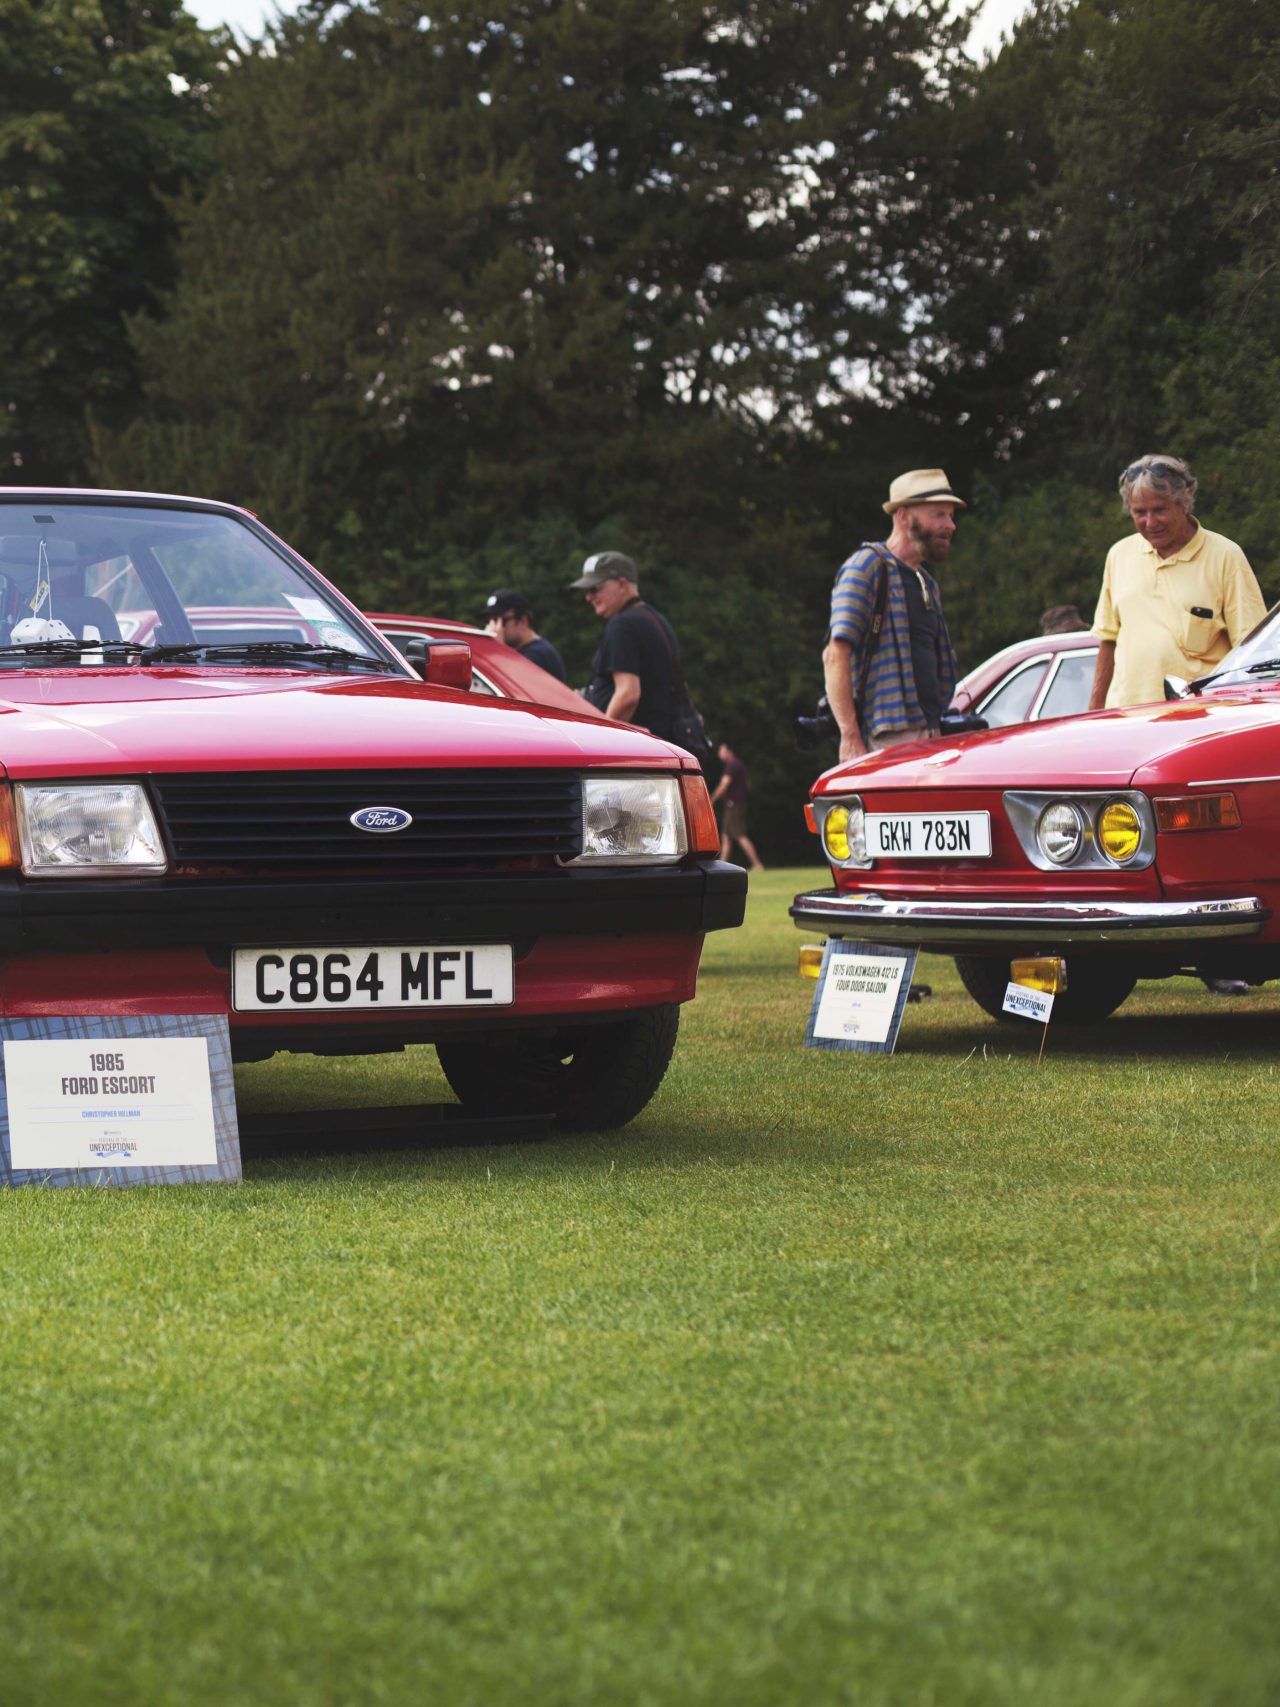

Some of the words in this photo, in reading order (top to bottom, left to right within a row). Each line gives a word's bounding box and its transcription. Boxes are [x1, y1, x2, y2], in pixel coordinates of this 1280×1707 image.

[365, 811, 398, 826] Ford
[879, 821, 912, 851] GKW
[922, 819, 971, 851] 783N
[255, 952, 384, 1004] C864
[400, 951, 493, 1001] MFL
[832, 964, 845, 976] 1975
[845, 965, 881, 978] VOLKSWAGEN
[835, 979, 850, 991] FOUR
[850, 980, 865, 993] DOOR
[865, 982, 888, 994] SALOON
[1006, 993, 1047, 1013] UNEXCEPTIONAL
[89, 1053, 124, 1071] 1985
[62, 1077, 99, 1095] FORD
[102, 1075, 156, 1095] ESCORT
[89, 1142, 138, 1152] UNEXCEPTIONAL
